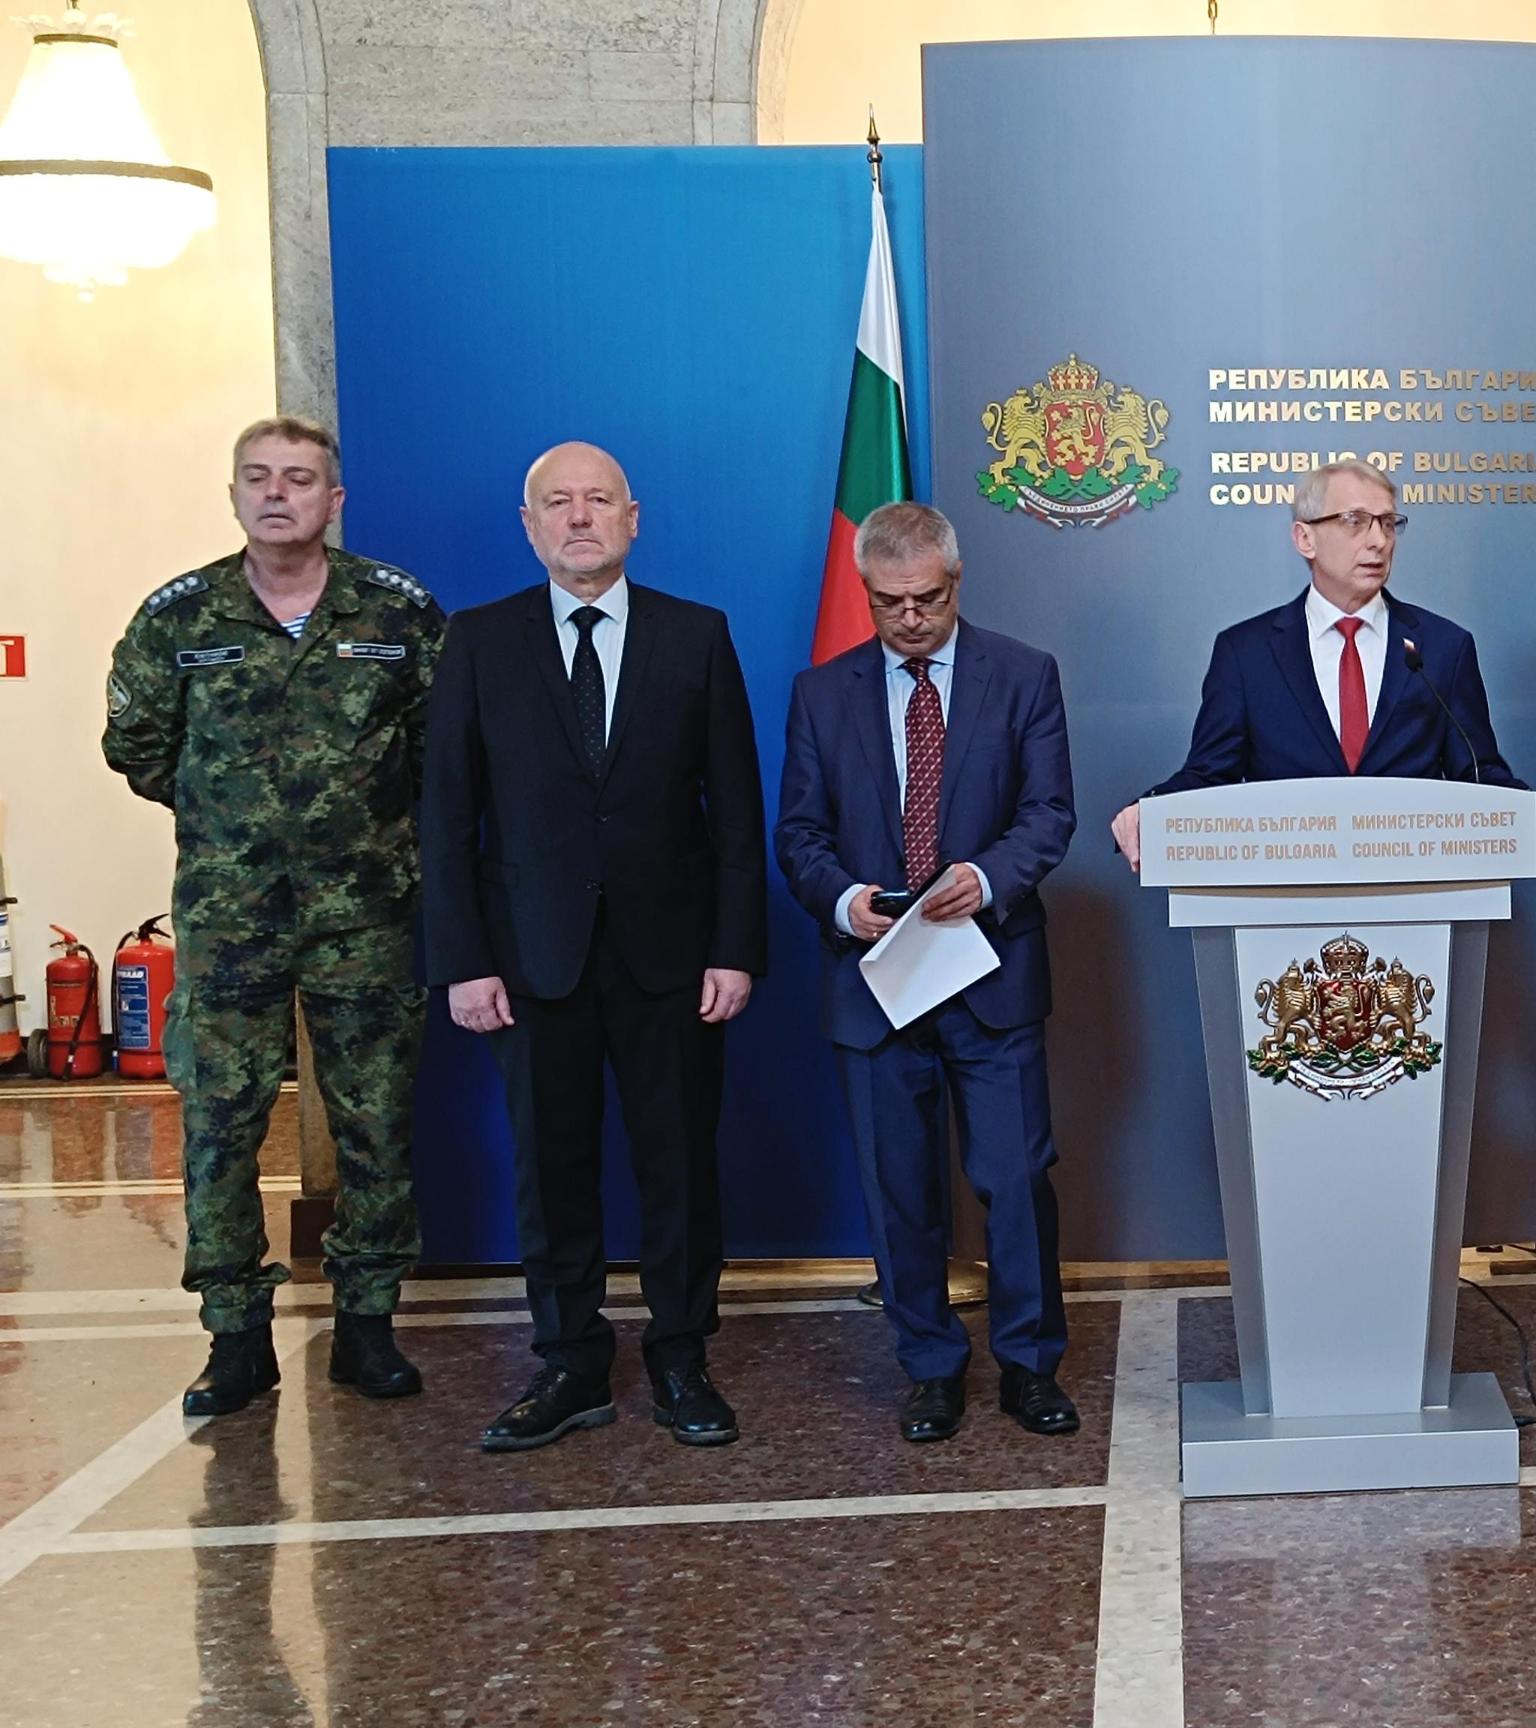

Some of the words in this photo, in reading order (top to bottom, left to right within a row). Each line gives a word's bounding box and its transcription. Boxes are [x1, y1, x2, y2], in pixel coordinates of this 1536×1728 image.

[1208, 369, 1389, 390] РЕПУБЛИКА
[1208, 401, 1445, 423] МИНИСТЕРСКИ
[1367, 452, 1404, 472] OF
[1209, 484, 1296, 505] COUN
[1165, 817, 1255, 833] РЕПУБЛИКА
[1258, 815, 1337, 832] БЪЛГАРИЯ
[1351, 812, 1465, 830] МИНИСТЕРСКИ
[1470, 811, 1517, 828] СЪВЕТ
[1166, 845, 1238, 861] REPUBLIC
[1241, 844, 1260, 860] OF
[1264, 843, 1337, 860] BULGARIA
[1352, 841, 1414, 858] COUNCIL
[1418, 840, 1436, 857] OF
[1441, 838, 1517, 856] MINISTERS
